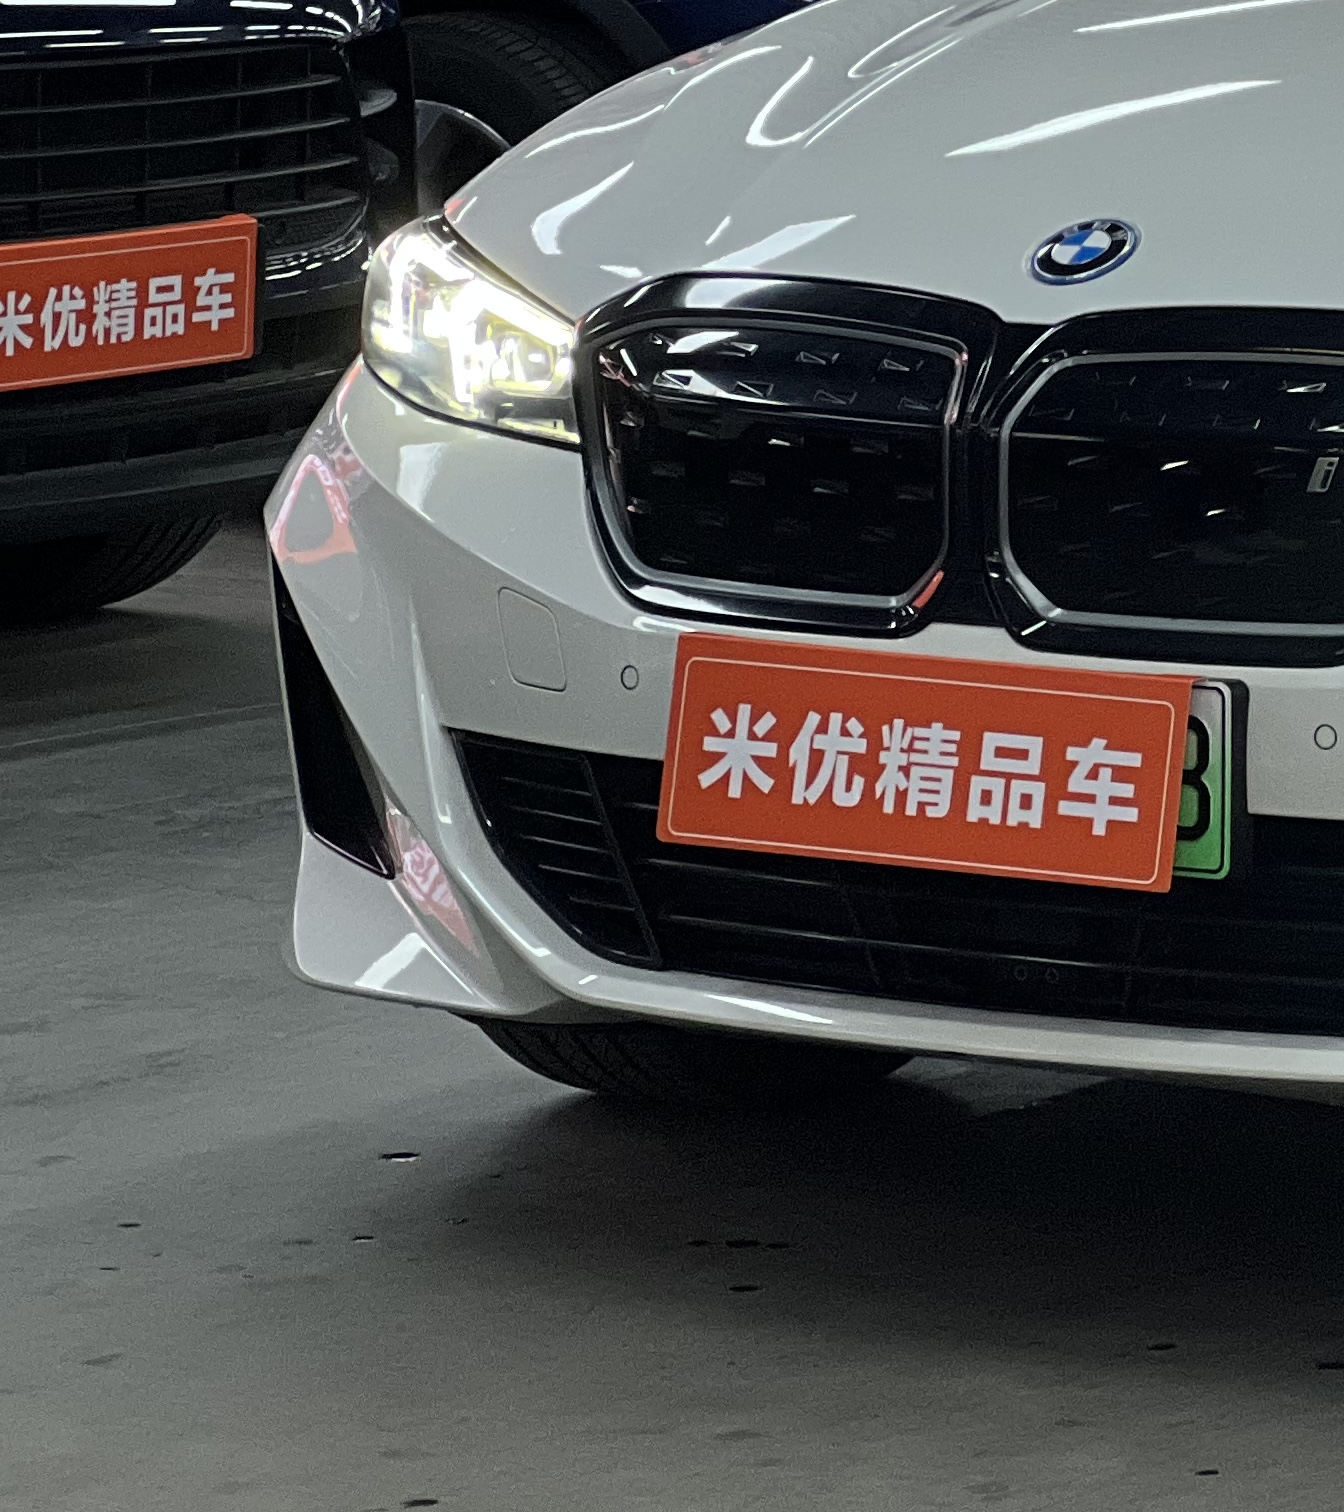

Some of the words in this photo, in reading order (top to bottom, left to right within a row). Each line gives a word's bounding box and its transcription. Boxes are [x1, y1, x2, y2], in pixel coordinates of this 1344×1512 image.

[0, 267, 236, 357] 米优精品车
[696, 703, 1143, 836] 米优精品车
